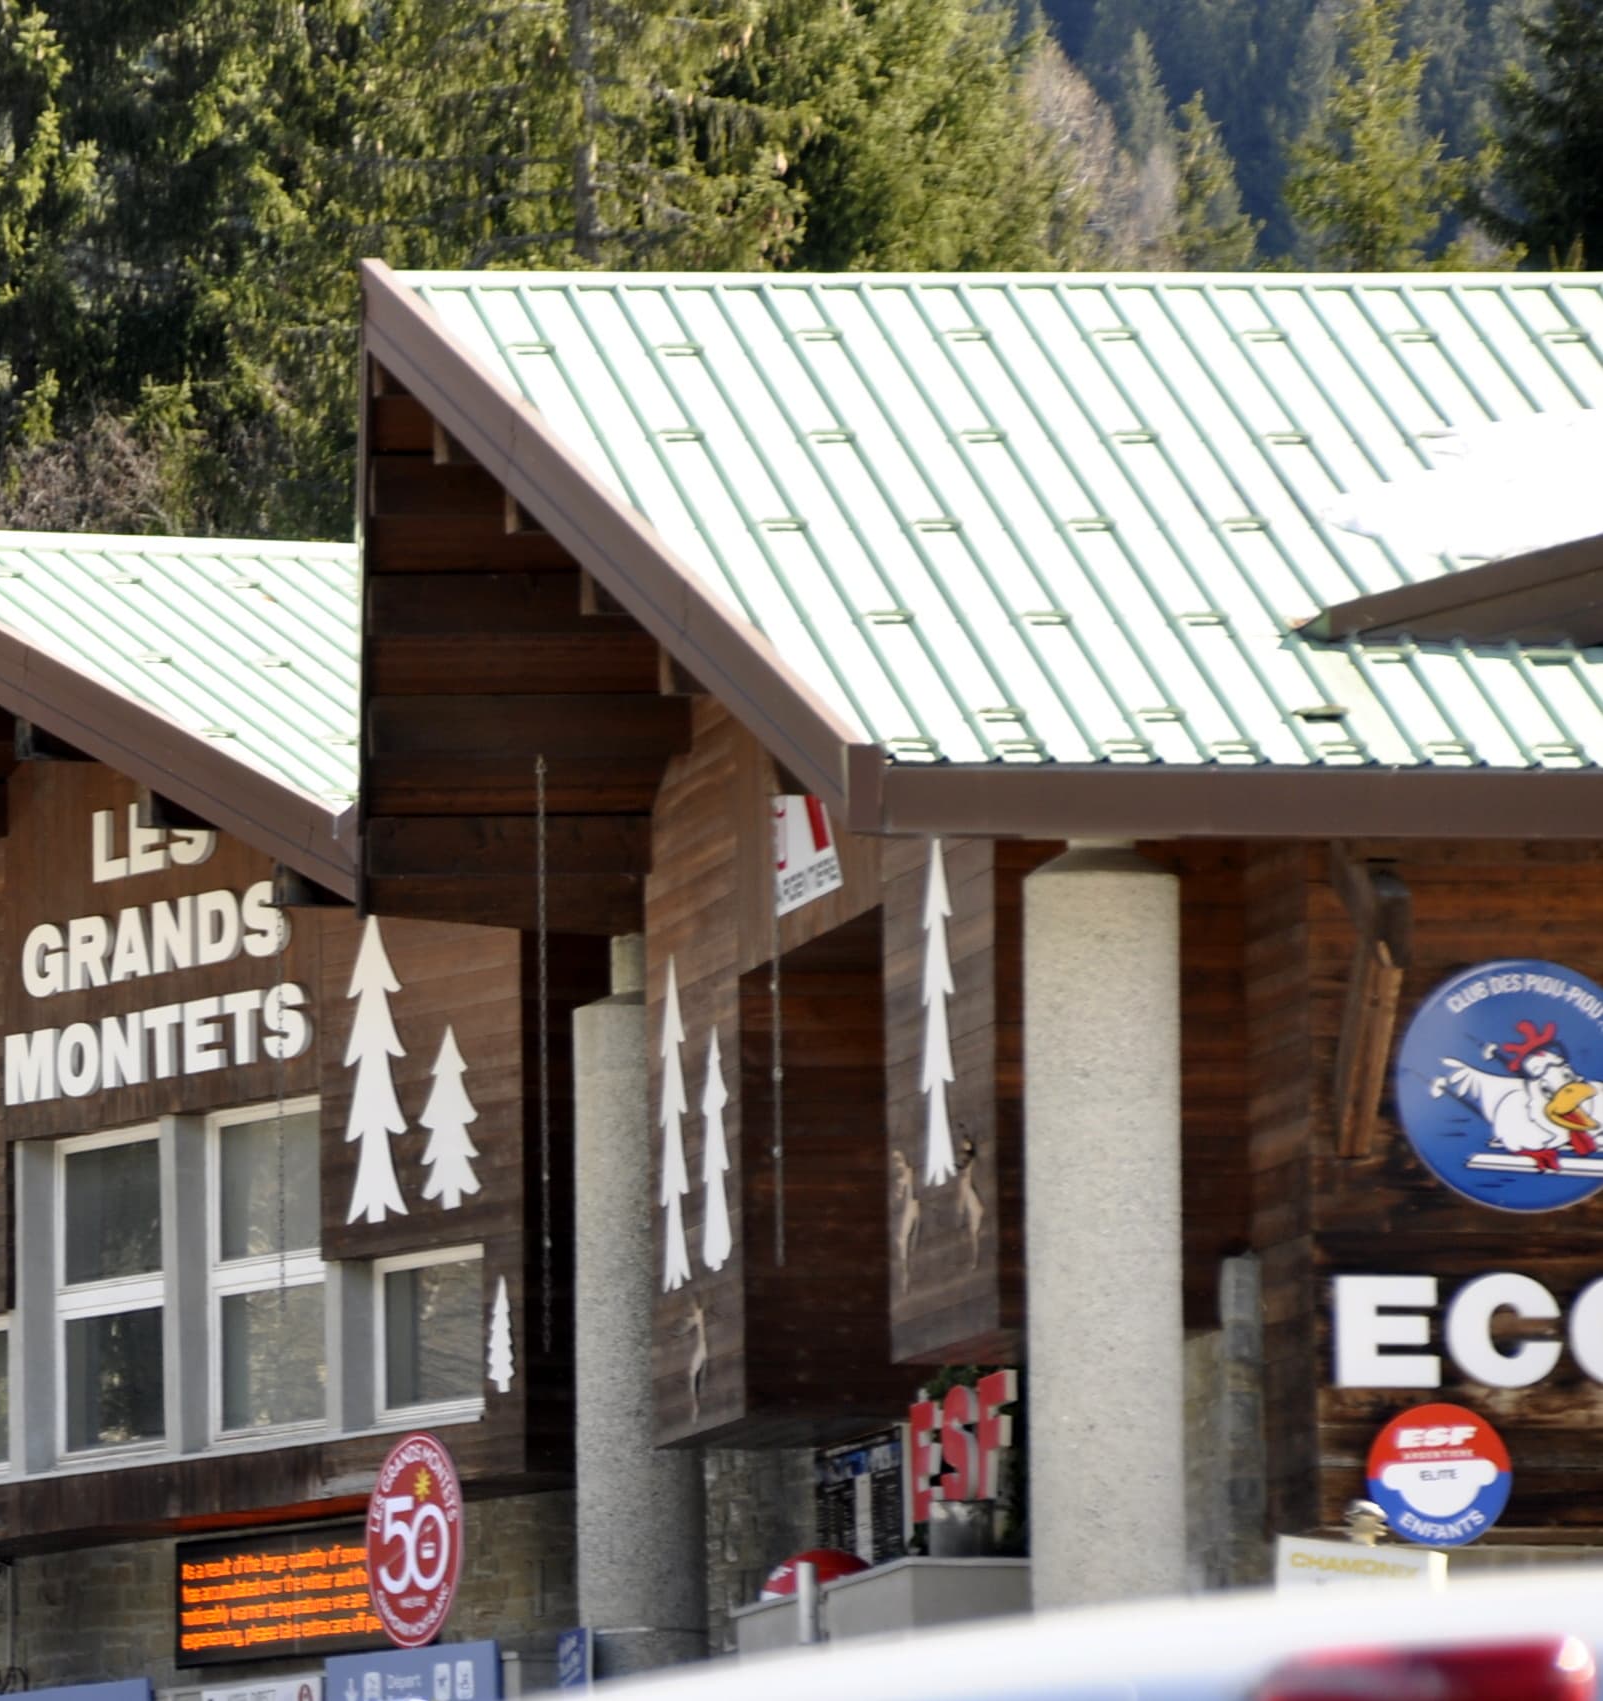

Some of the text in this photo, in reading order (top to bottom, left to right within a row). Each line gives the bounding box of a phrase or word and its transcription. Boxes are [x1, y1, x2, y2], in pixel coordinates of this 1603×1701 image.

[21, 881, 290, 998] GRANDS
[1447, 981, 1490, 1013] CLUB
[1489, 973, 1523, 995] DES
[5, 983, 312, 1106] MONTETS
[1333, 1271, 1603, 1388] EC
[909, 1369, 1018, 1523] ESF
[1396, 1426, 1477, 1449] ESF
[1419, 1468, 1460, 1481] ELITE
[369, 1494, 386, 1533] LES
[380, 1444, 422, 1493] GRANDS
[1399, 1509, 1486, 1540] ENFANTS
[379, 1495, 450, 1594] 50
